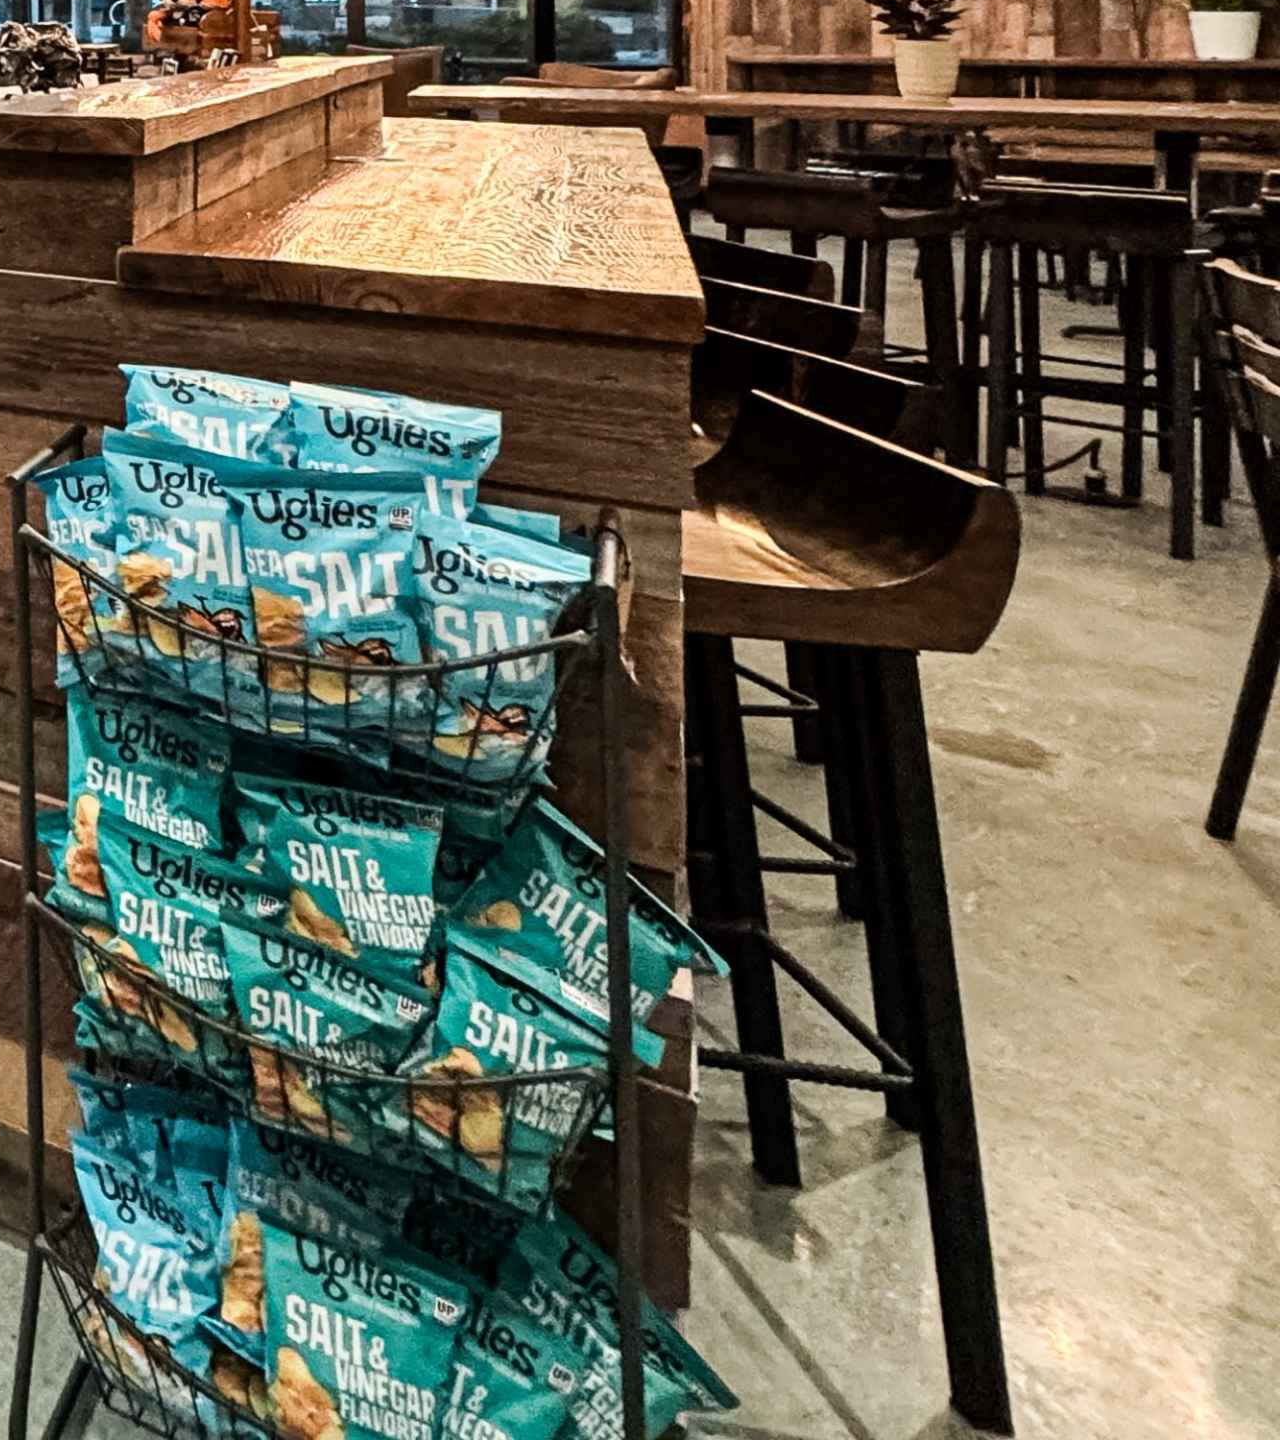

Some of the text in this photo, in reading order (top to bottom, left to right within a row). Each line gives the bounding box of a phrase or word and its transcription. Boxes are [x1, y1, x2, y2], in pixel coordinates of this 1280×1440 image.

[318, 405, 452, 458] Uglies
[59, 474, 112, 513] Ugl
[129, 460, 225, 509] Uglie
[244, 487, 378, 541] Uglies
[49, 519, 83, 545] SEA
[126, 513, 250, 588] SEA SAL
[246, 548, 406, 620] SEA SALT
[96, 709, 202, 769] Uglies
[85, 756, 169, 815] SALT &
[278, 786, 406, 837] Uglies
[124, 803, 210, 850] VINEGAR
[127, 835, 246, 910] Uglies
[286, 838, 387, 894] SALT &
[117, 890, 208, 953] SALT &
[335, 886, 436, 928] VINEGAR
[159, 942, 231, 981] VINEG
[258, 935, 385, 1011] Uglies
[248, 984, 343, 1049] SALT &
[464, 999, 559, 1074] SALT
[91, 1160, 188, 1235] Uglies
[293, 1234, 422, 1315] Uglies
[284, 1292, 389, 1373] SALT &
[438, 1301, 457, 1316] UP
[464, 1295, 540, 1378] lies
[335, 1358, 437, 1421] VINEGAR
[553, 1366, 572, 1382] UP
